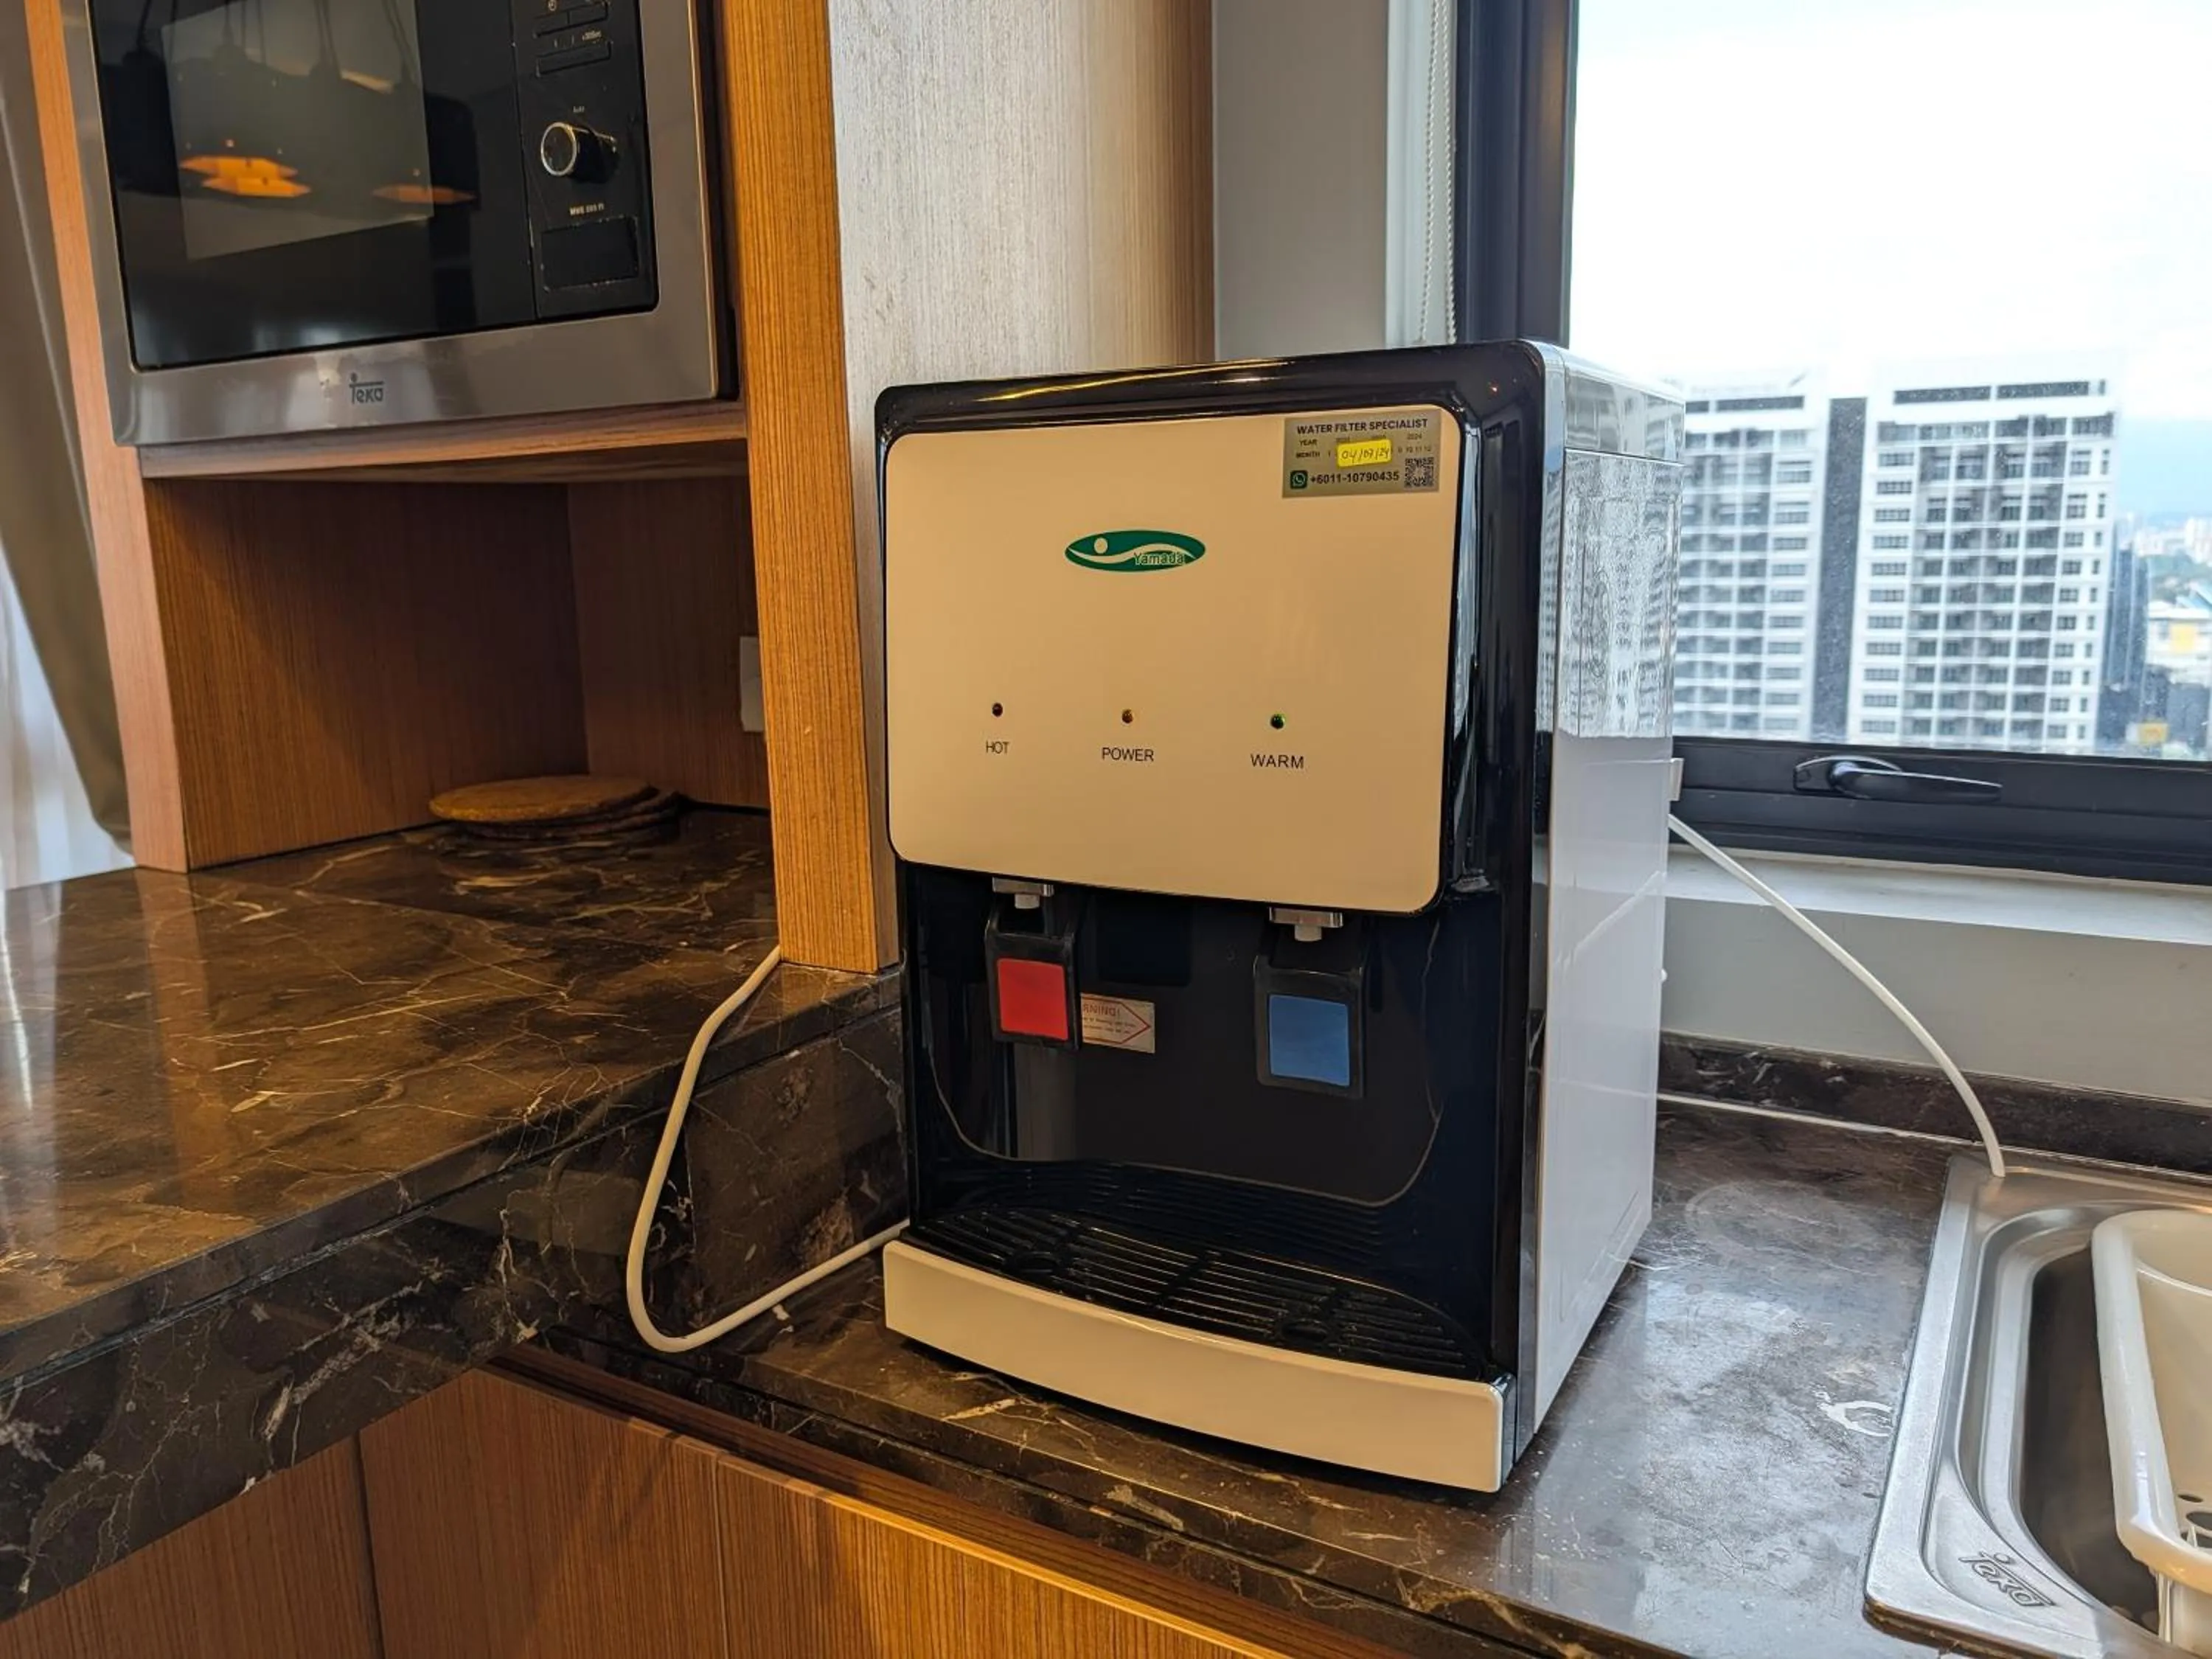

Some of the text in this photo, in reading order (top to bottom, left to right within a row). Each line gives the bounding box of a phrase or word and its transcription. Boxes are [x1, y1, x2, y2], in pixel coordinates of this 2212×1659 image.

[1296, 418, 1428, 434] WATER FILTER SPECIALIST
[1299, 439, 1318, 447] YEAR
[1295, 451, 1321, 459] MONTH
[1310, 470, 1400, 484] +6011-10790435
[1133, 552, 1186, 566] Yamada
[984, 740, 1010, 754] HOT
[1101, 746, 1155, 762] POWER
[1250, 753, 1305, 770] WARM
[1082, 1004, 1121, 1017] RNING!
